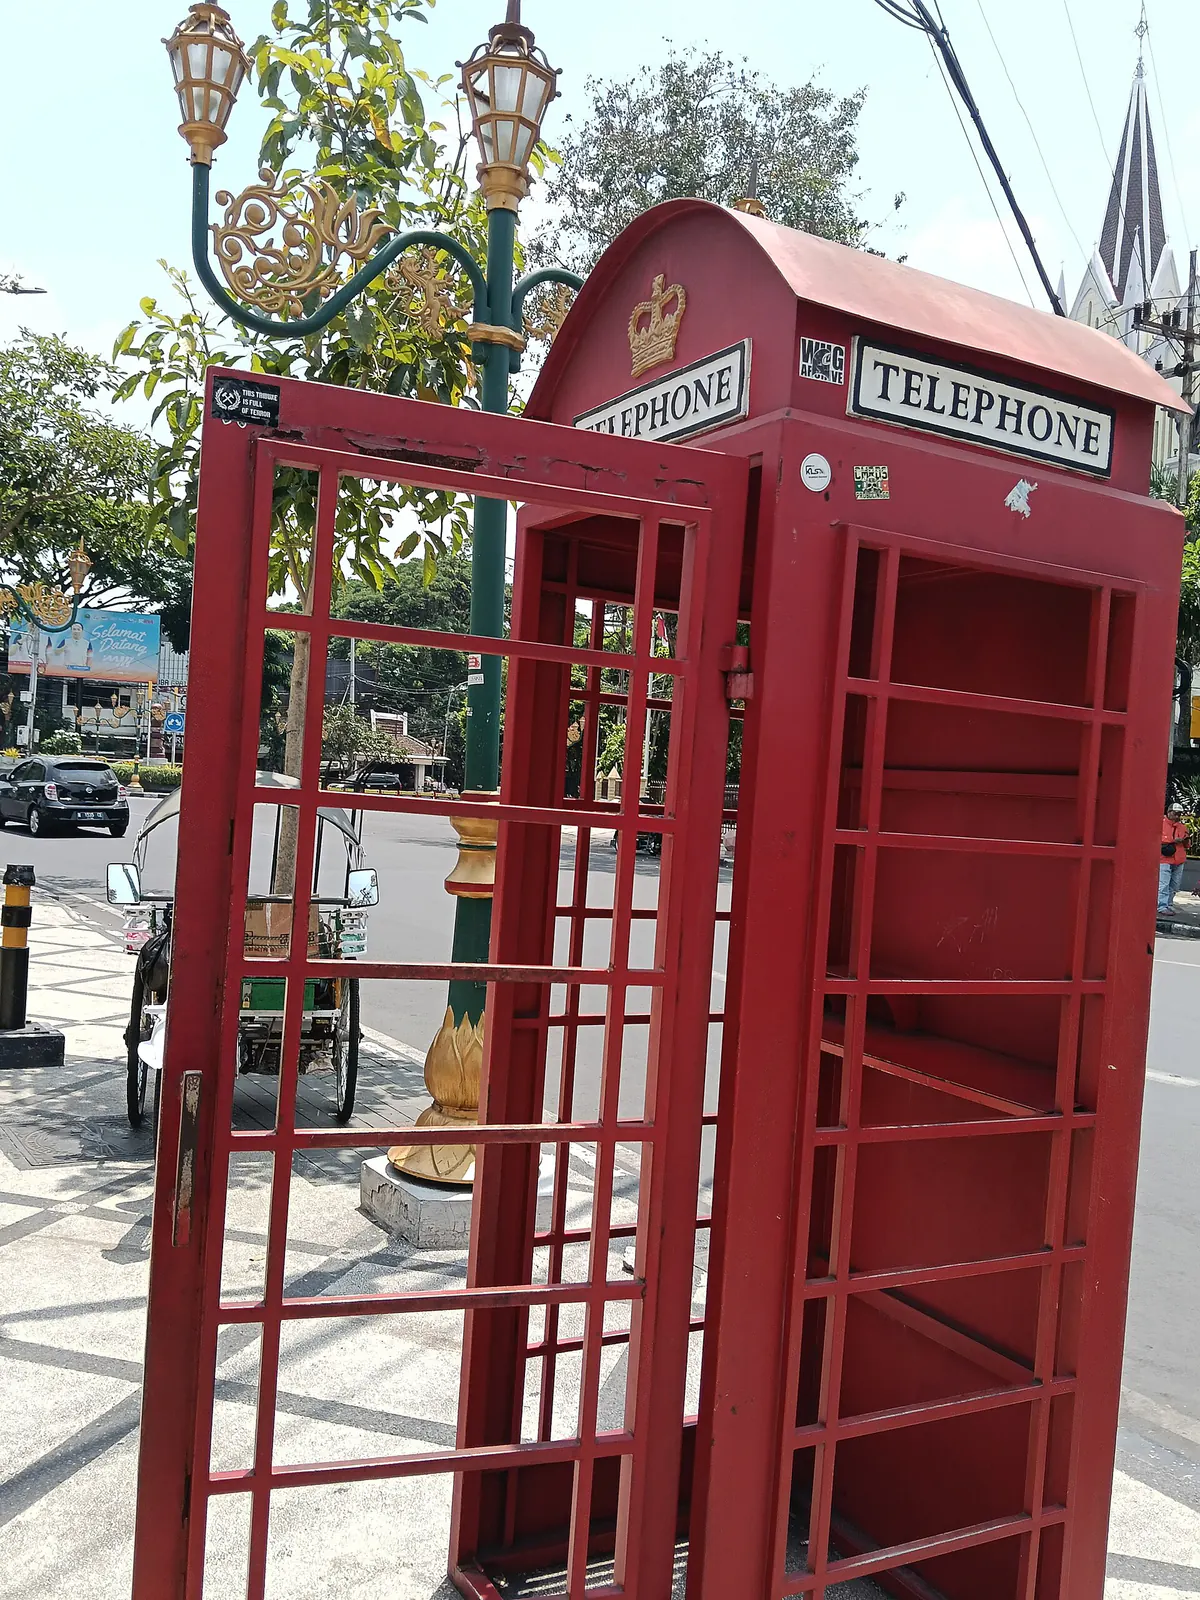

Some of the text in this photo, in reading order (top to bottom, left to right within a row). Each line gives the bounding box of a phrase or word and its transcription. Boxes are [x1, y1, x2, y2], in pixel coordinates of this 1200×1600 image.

[242, 389, 255, 398] THIS
[242, 398, 263, 408] IS FULL
[584, 365, 732, 439] LEPHONE
[250, 408, 271, 418] TERROR
[873, 360, 1101, 457] TELEPHONE
[90, 622, 147, 642] Selamat
[99, 637, 148, 657] Datang
